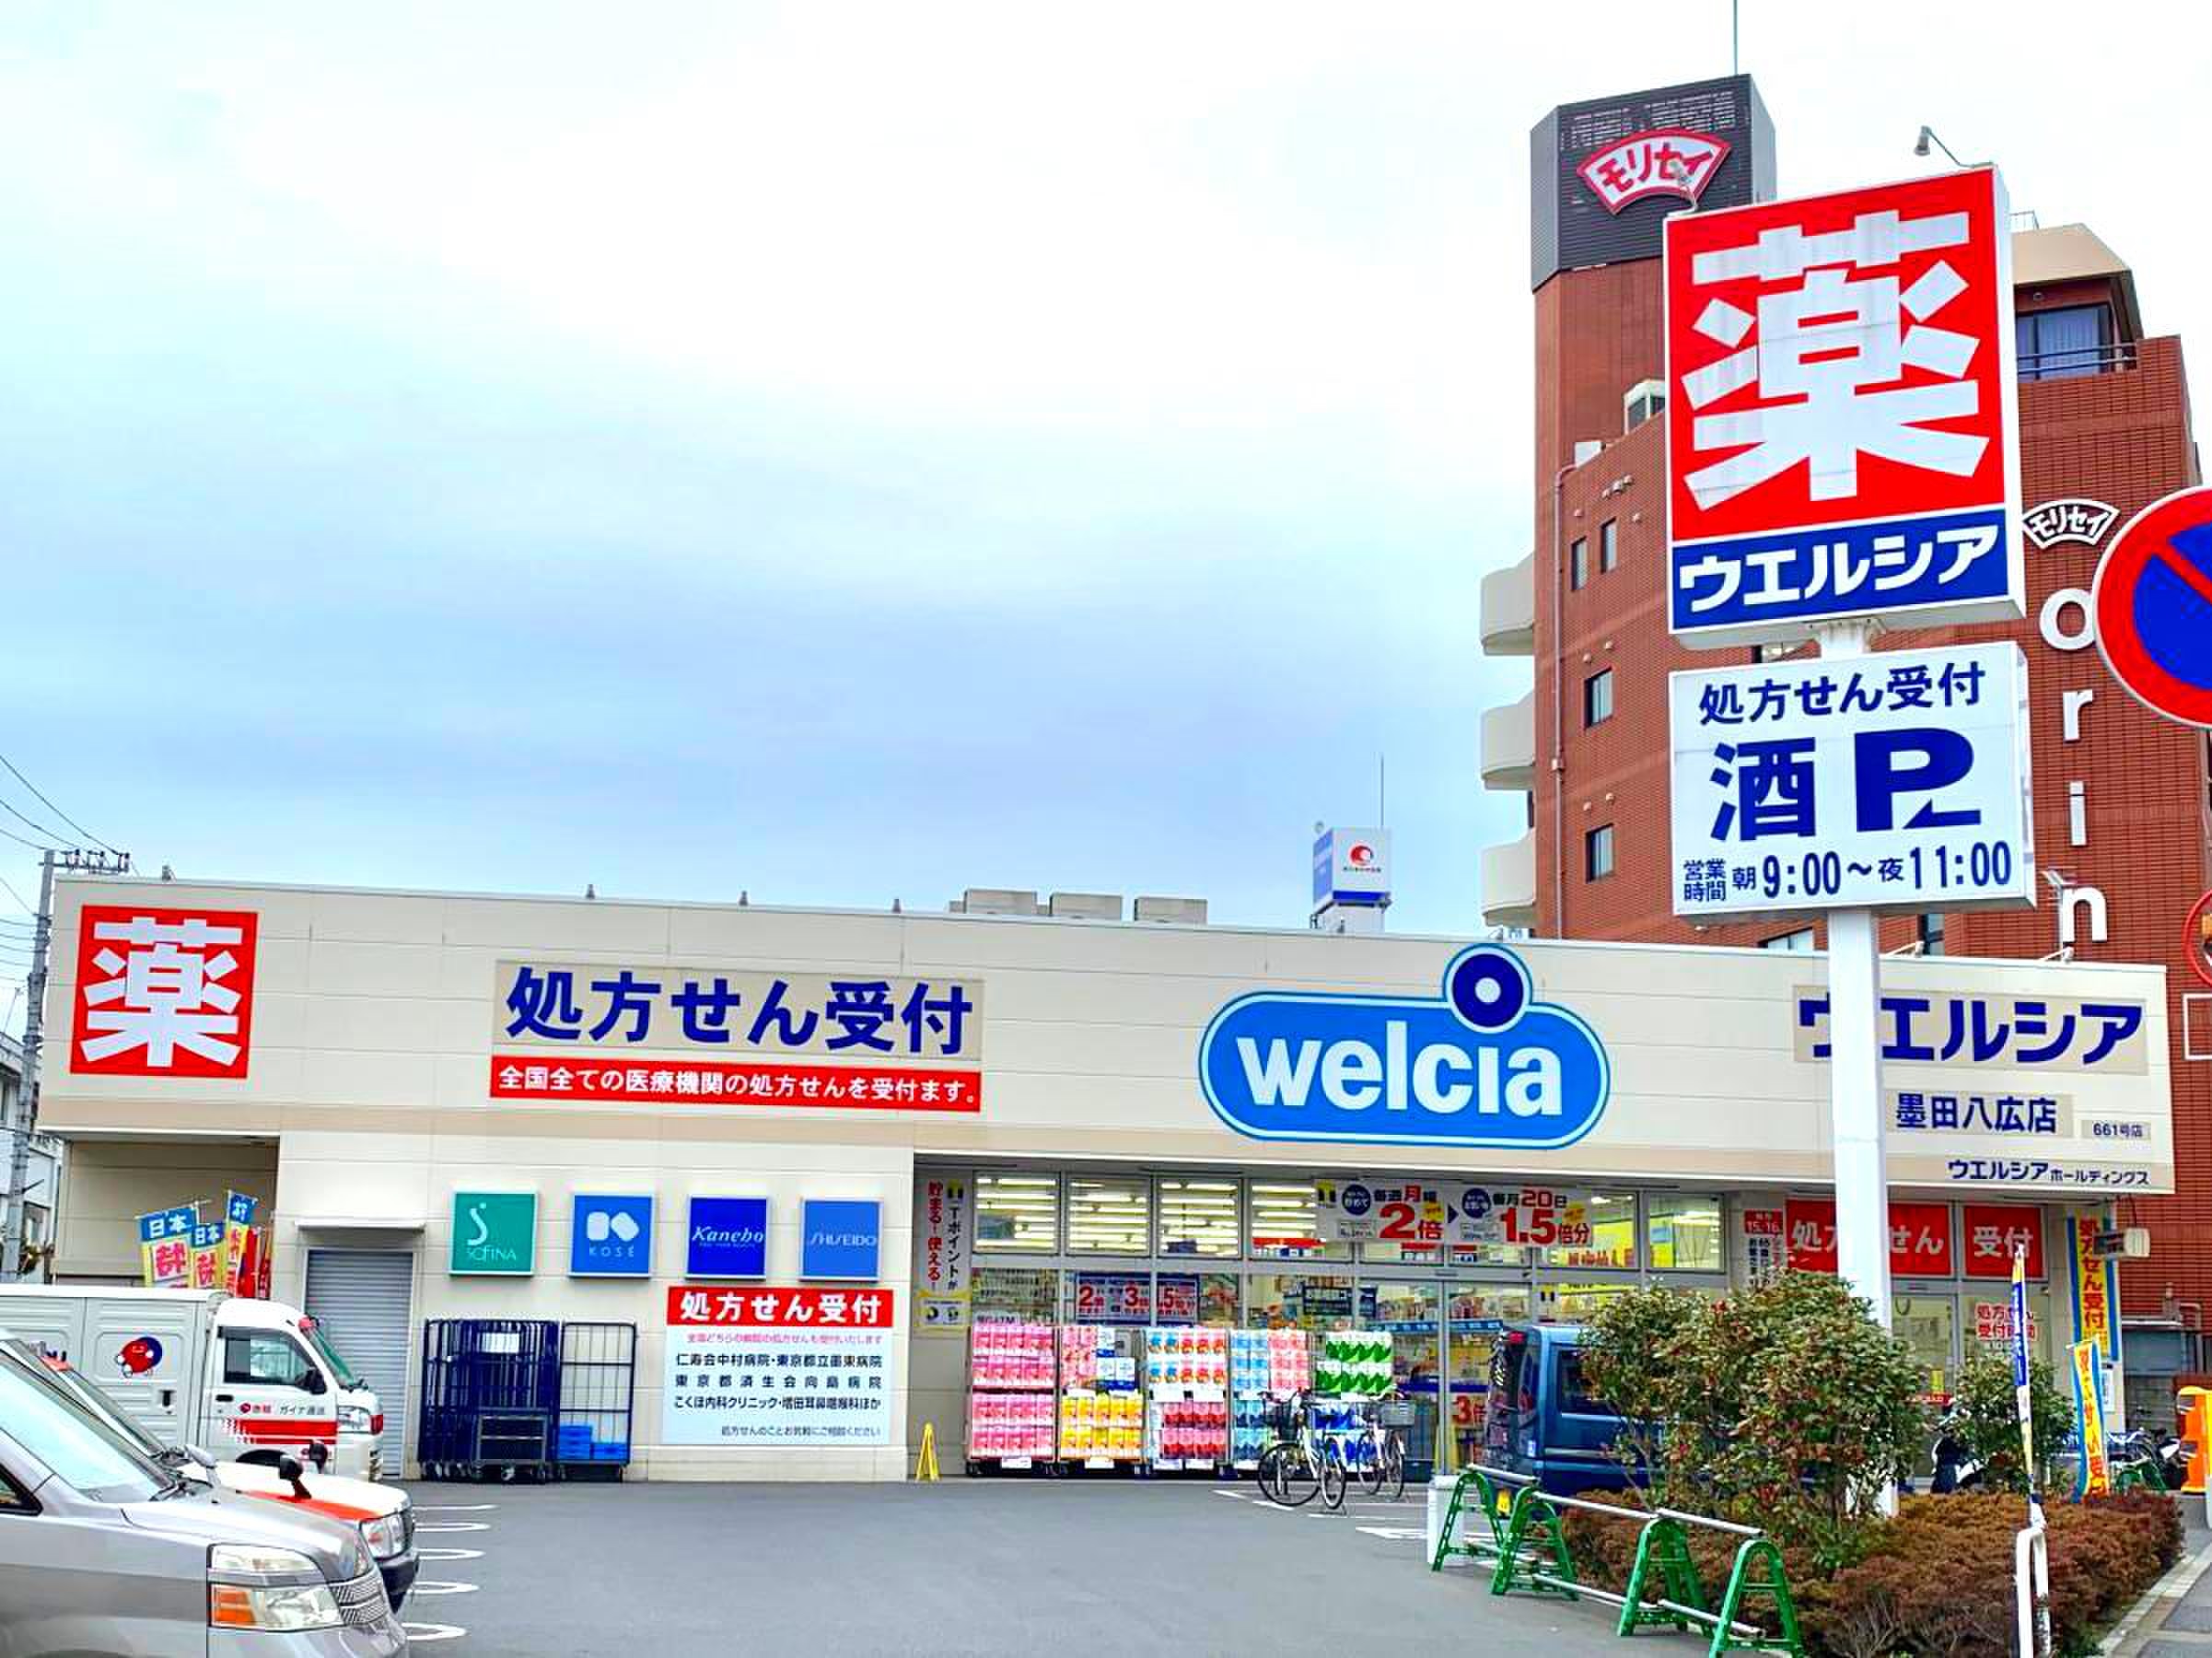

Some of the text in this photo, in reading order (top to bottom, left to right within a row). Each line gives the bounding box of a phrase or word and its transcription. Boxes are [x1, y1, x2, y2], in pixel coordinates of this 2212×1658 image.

[1597, 141, 1713, 192] モリセイ
[1682, 209, 1990, 511] 薬
[2030, 506, 2110, 537] モリセイ
[1680, 524, 1999, 613] ウエルシア
[1700, 661, 1985, 726] 処方せん受付
[1709, 727, 1974, 842] 酒 P
[1683, 858, 1727, 882] 営業
[1683, 882, 1727, 903] 時間
[80, 916, 242, 1068] 薬
[506, 966, 973, 1055] 処方せん受付
[498, 1067, 977, 1103] 全国全ての医療機関の処方せんを受付ます。
[1237, 1020, 1563, 1116] welcia
[1896, 1092, 2057, 1134] 墨田八広店
[2092, 1122, 2144, 1138] 661号店
[148, 1214, 192, 1239] 日本
[194, 1225, 221, 1245] 日本
[692, 1226, 764, 1244] Kanebo
[680, 1291, 882, 1324] 処方せん受付
